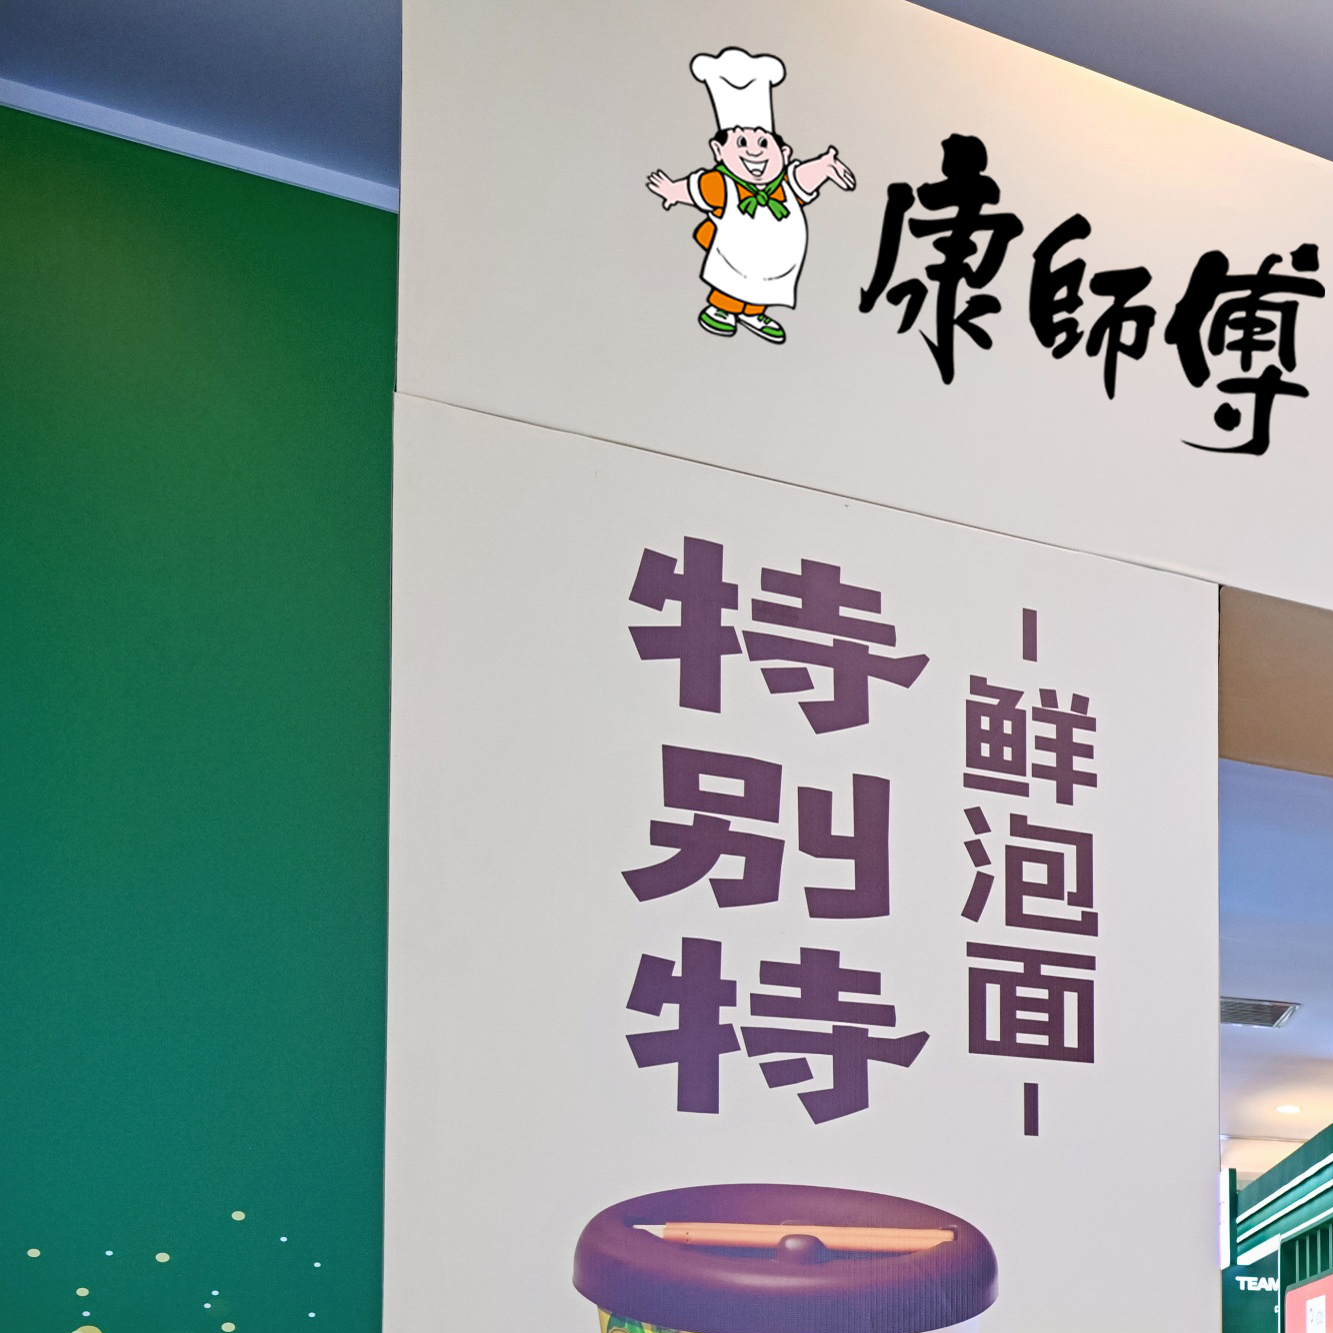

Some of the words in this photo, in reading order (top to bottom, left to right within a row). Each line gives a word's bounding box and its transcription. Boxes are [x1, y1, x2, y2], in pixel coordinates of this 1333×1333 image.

[858, 133, 1326, 456] 康師傅
[620, 535, 930, 1125] 特别特
